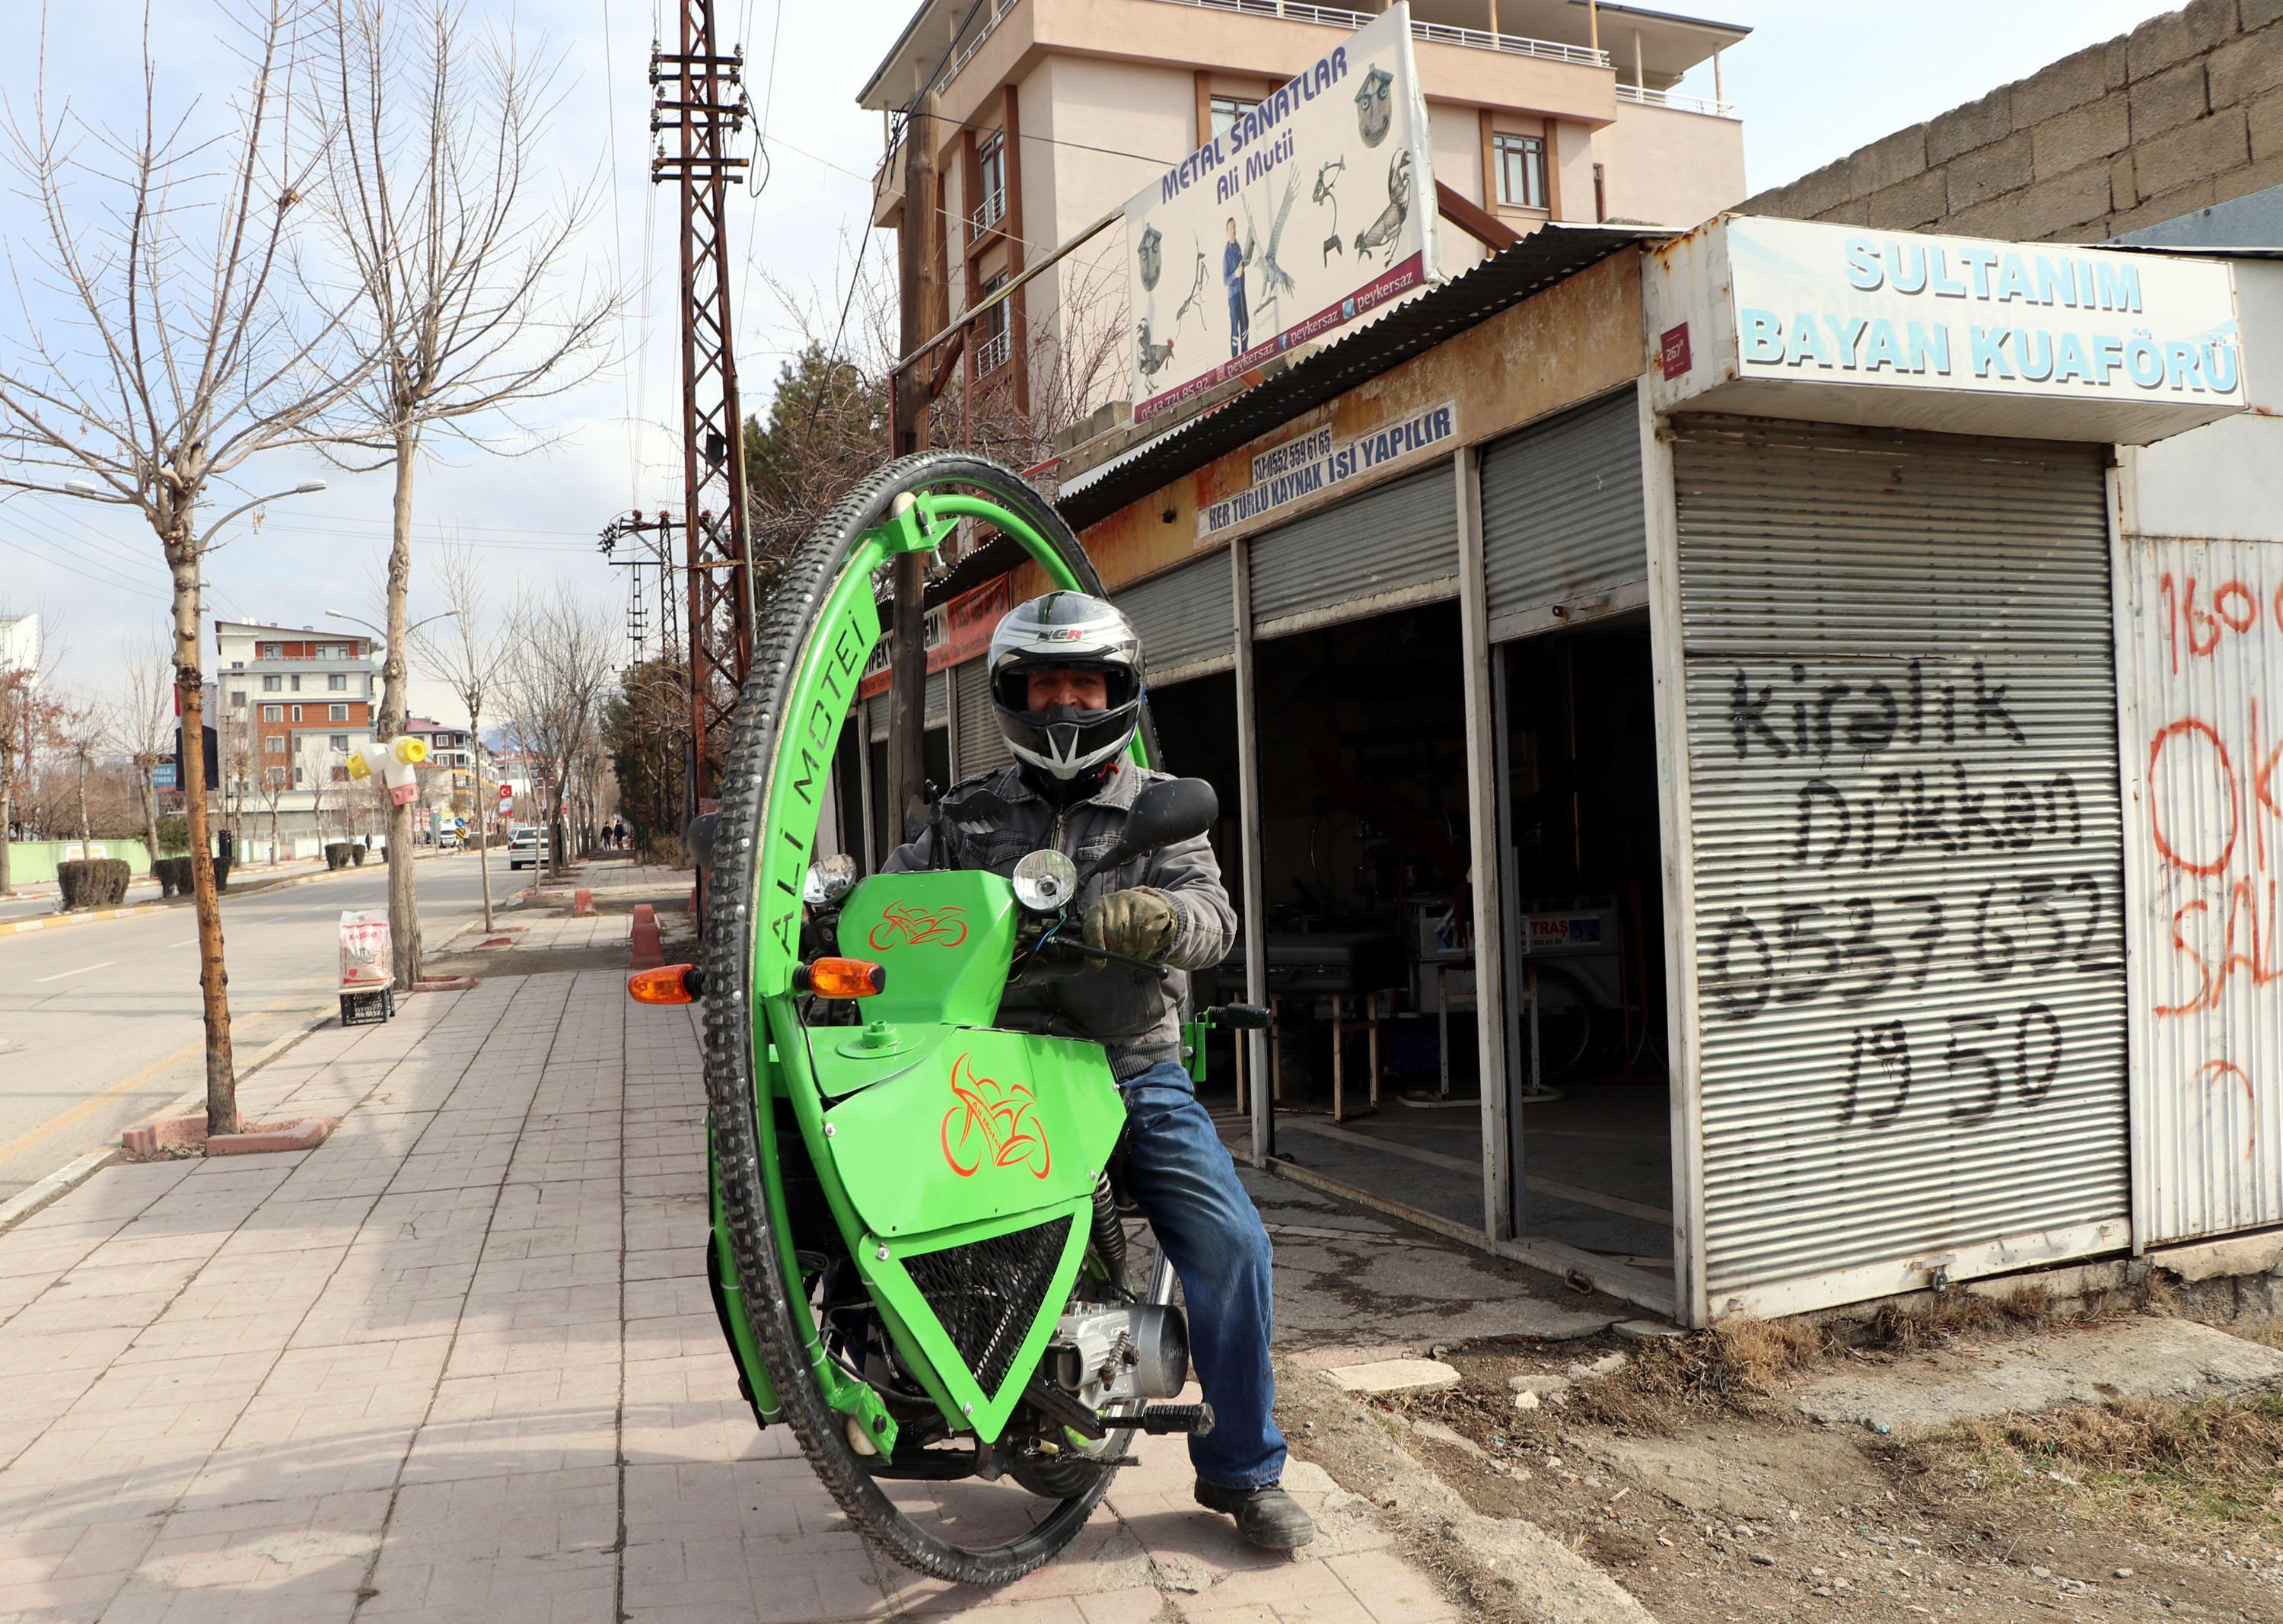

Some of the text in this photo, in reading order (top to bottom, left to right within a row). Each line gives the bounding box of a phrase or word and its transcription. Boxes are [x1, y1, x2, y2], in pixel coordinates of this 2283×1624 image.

[1162, 46, 1348, 205] METAL SANATLAR
[1246, 127, 1294, 186] Mutii
[1357, 271, 1414, 313] peykersaz
[1844, 237, 2142, 311] SULTANIM
[1290, 310, 1339, 343] peykersaz
[1740, 307, 2240, 394] BAYAN KUAFÖRÜ
[1227, 343, 1275, 376] peykersaz
[1142, 400, 1164, 421] 0543
[1182, 384, 1195, 400] 85
[1196, 377, 1211, 393] 92
[1209, 503, 1230, 531] HER
[1232, 482, 1269, 523] TÜRLÜ
[1272, 462, 1323, 506] KAYNAK
[1361, 407, 1451, 468] YAPILIR
[1290, 440, 1307, 467] 559
[1307, 435, 1317, 460] 61
[1319, 429, 1330, 455] 65
[1714, 894, 1945, 1020] 0537
